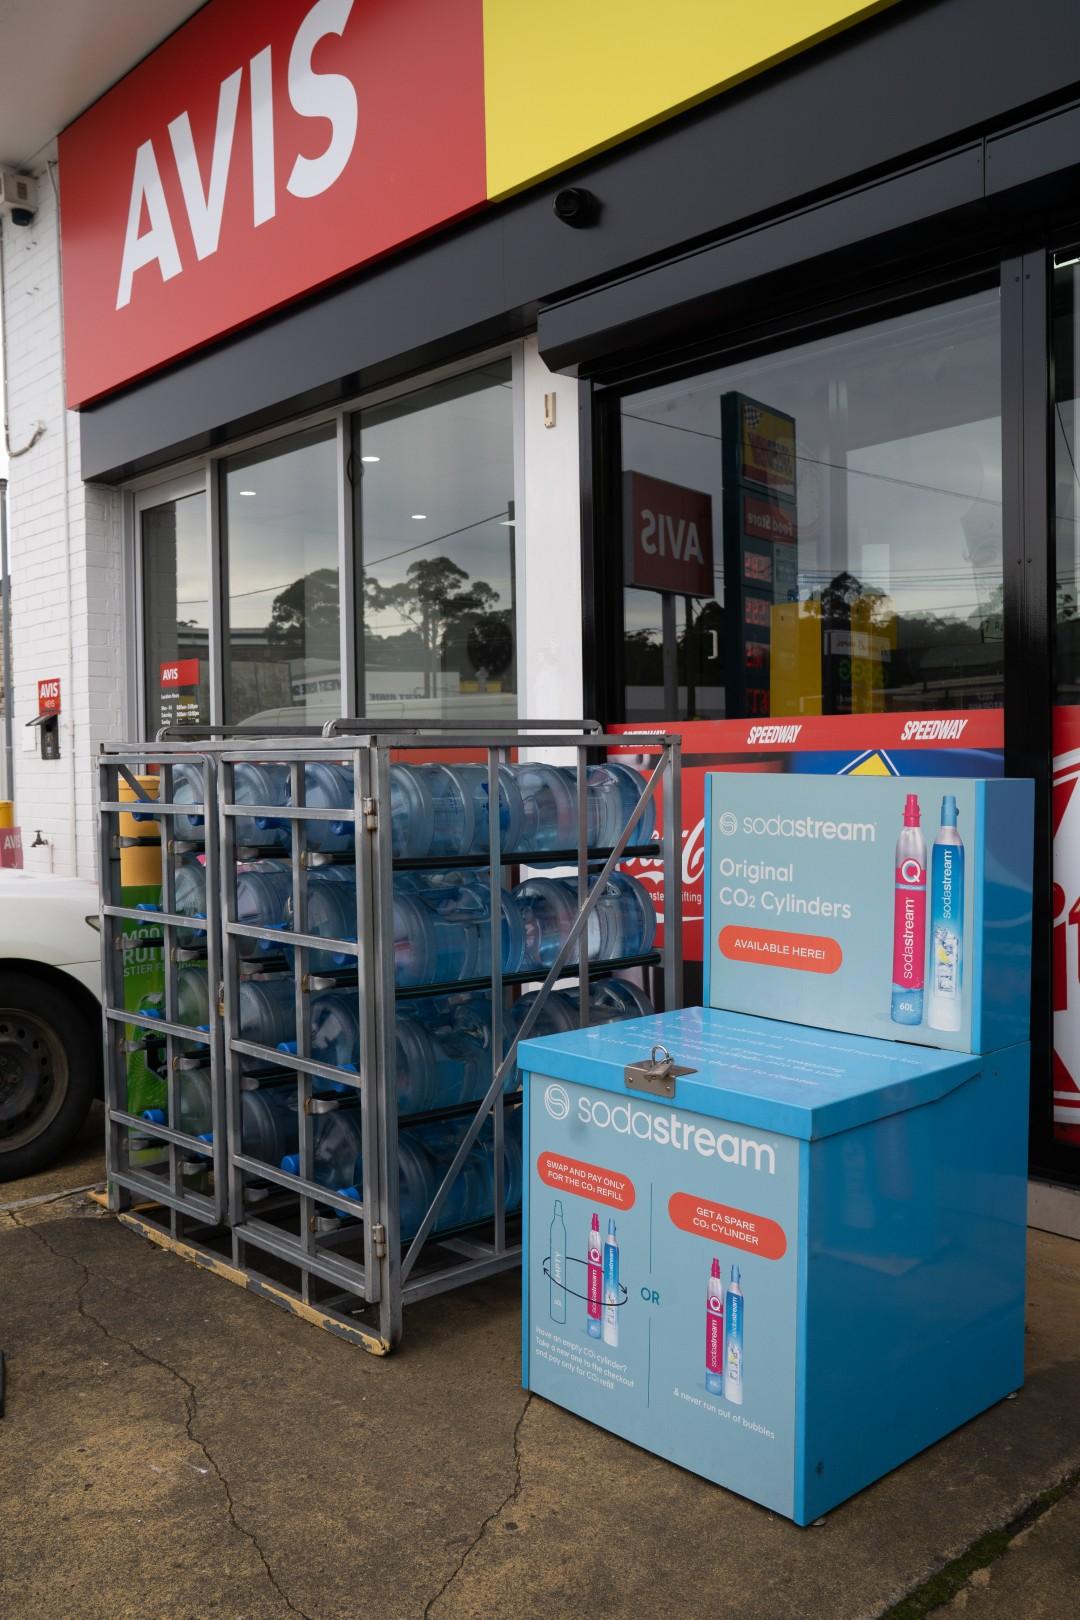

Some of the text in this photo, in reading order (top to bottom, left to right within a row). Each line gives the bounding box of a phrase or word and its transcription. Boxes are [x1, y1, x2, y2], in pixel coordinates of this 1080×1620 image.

[115, 0, 359, 311] AVIS
[162, 668, 178, 680] AVIS
[40, 682, 58, 698] AVIS
[747, 725, 802, 744] SPEEDWAY
[901, 719, 968, 741] SPEEDWAY
[743, 815, 876, 842] sodastream
[720, 858, 793, 884] Original
[943, 849, 953, 919] sodastream
[761, 891, 852, 919] Cylinders
[734, 939, 826, 960] AVAILABLE HERE!
[903, 897, 914, 979] sodastream
[578, 1097, 776, 1175] sodastream
[546, 1160, 625, 1190] SWAP AND PAY ONLY
[547, 1170, 564, 1182] FOR
[565, 1176, 580, 1187] THE
[596, 1186, 624, 1202] REFILL
[696, 1207, 756, 1232] GET A SPARE
[711, 1223, 759, 1246] CYLINDER
[641, 1287, 660, 1305] OR
[680, 1392, 702, 1407] never
[703, 1402, 716, 1414] run
[742, 1417, 775, 1440] bubbles
